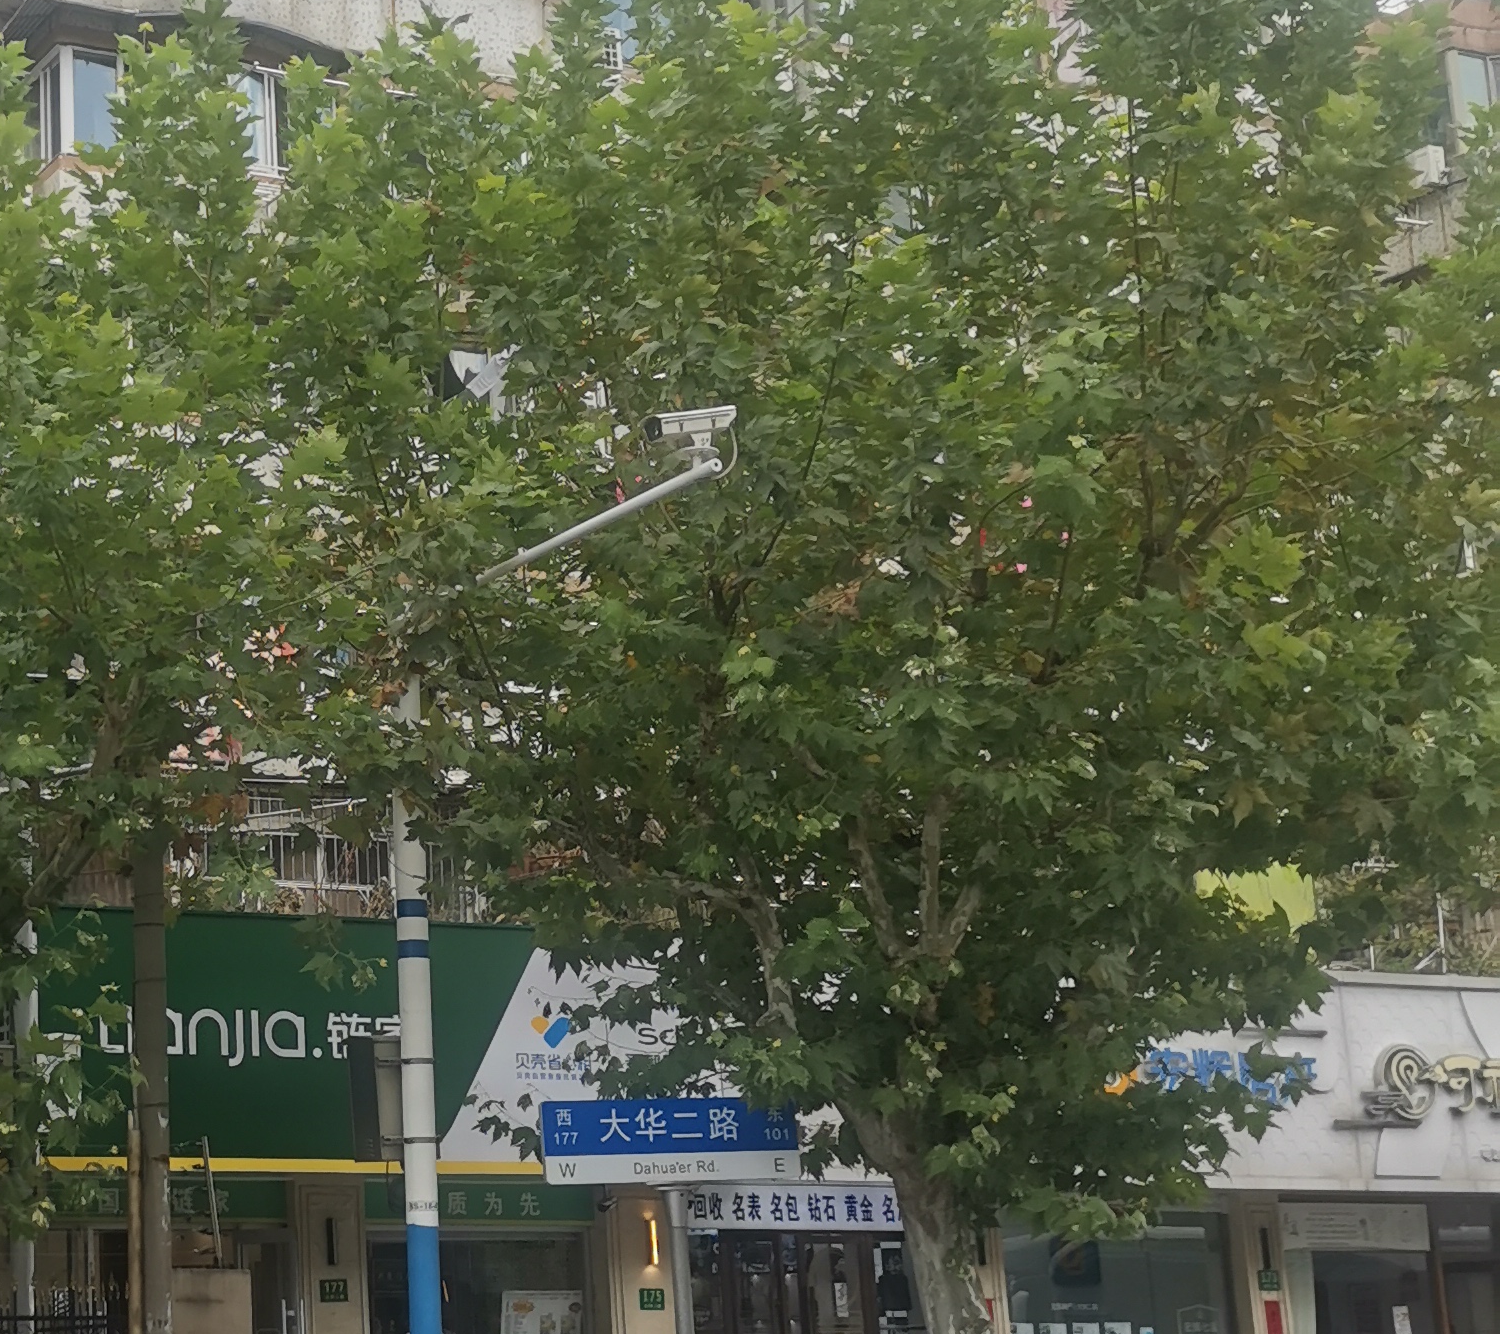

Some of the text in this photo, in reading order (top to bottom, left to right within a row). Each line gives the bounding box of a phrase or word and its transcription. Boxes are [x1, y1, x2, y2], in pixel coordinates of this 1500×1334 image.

[555, 1108, 572, 1127] 西
[767, 1107, 784, 1123] 东
[599, 1107, 739, 1143] 大华二路
[554, 1132, 578, 1146] 177
[763, 1128, 790, 1142] 101
[559, 1162, 577, 1178] W
[633, 1159, 720, 1175] Dahua'er Rd.
[774, 1158, 786, 1173] E
[688, 1192, 902, 1223] 回收 名表 名包 钻石 黄金 名
[324, 1281, 345, 1293] 177
[643, 1290, 662, 1302] 175
